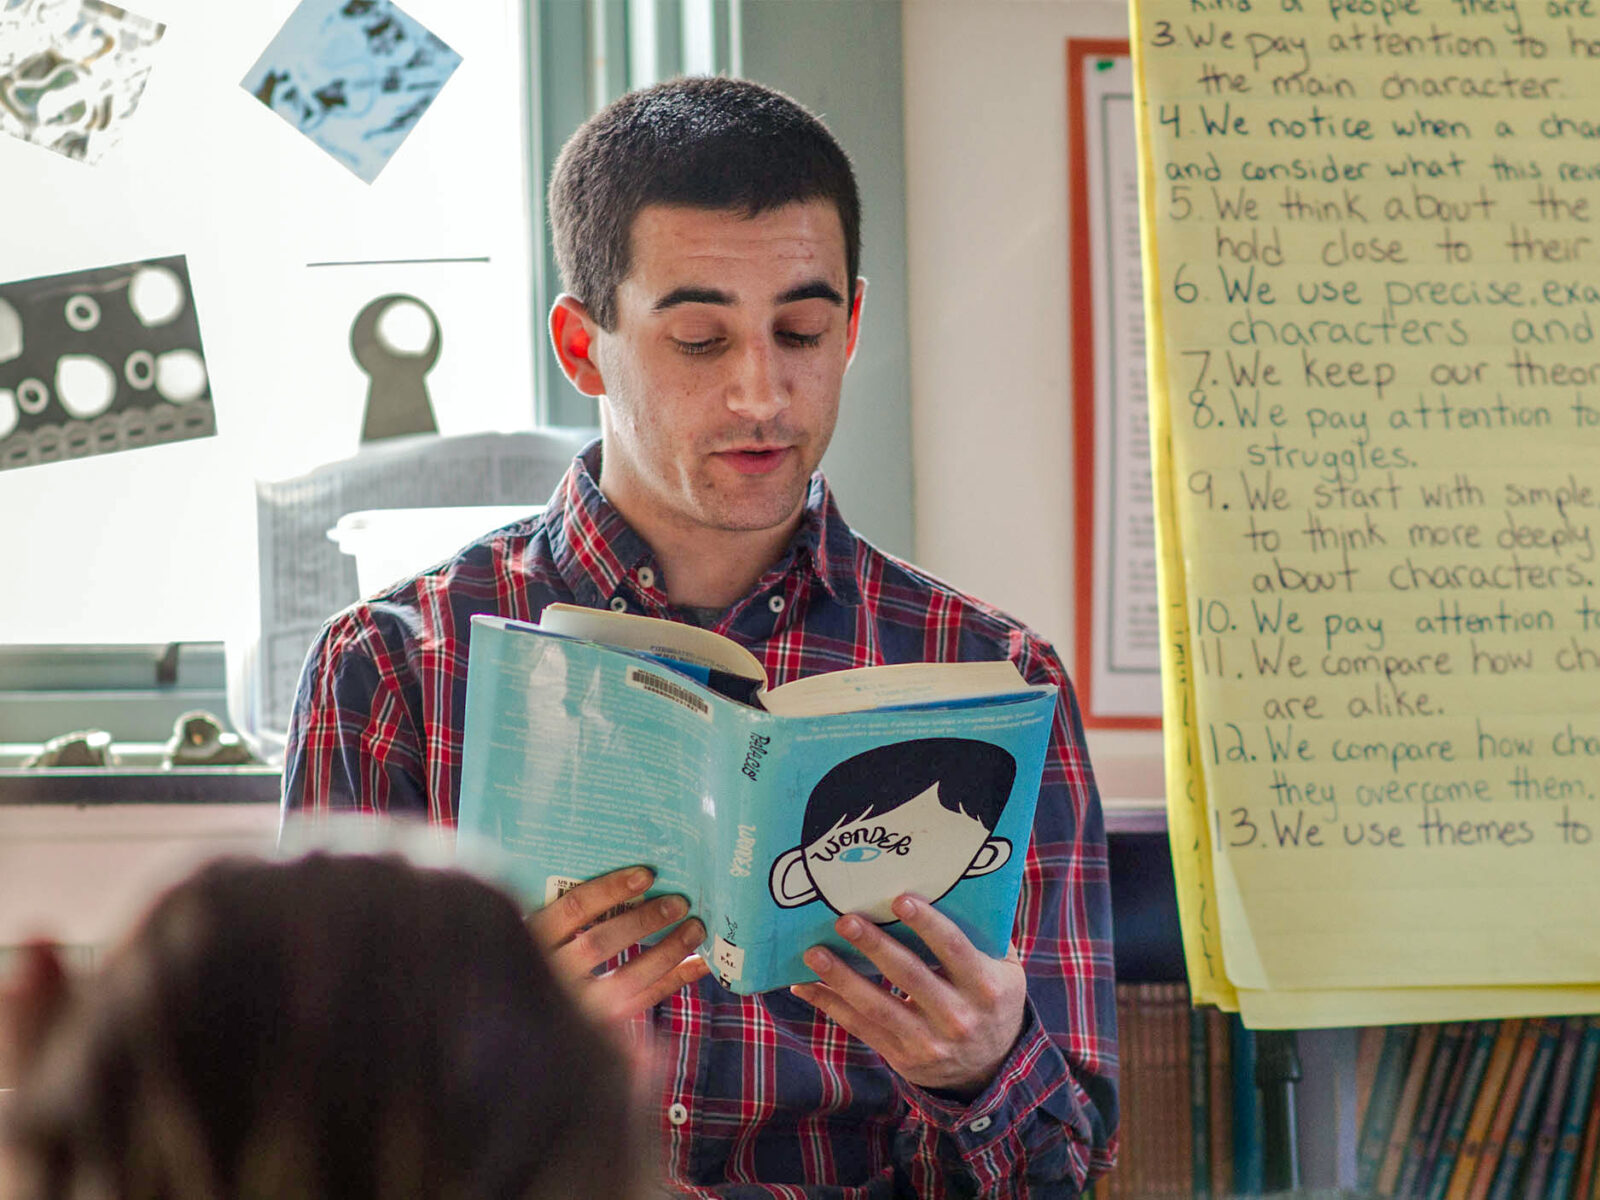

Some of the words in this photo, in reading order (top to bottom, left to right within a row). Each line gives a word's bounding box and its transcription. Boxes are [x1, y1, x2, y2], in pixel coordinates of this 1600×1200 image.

[1185, 21, 1235, 49] We
[1245, 33, 1311, 76] pay
[1328, 22, 1496, 56] attention
[1512, 34, 1548, 59] to
[1197, 63, 1252, 95] the
[1272, 73, 1356, 97] main
[1199, 102, 1249, 136] We
[1268, 105, 1375, 139] notice
[1392, 109, 1471, 139] when
[1495, 120, 1515, 138] a
[1540, 112, 1600, 139] cha
[1165, 151, 1222, 182] and
[1241, 153, 1371, 183] consider
[1386, 151, 1467, 179] what
[1488, 153, 1543, 182] this
[1211, 186, 1259, 220] We
[1279, 186, 1368, 223] think
[1383, 183, 1497, 222] about
[1529, 183, 1590, 222] the
[1216, 226, 1285, 267] hold
[1321, 227, 1409, 267] close
[1435, 226, 1473, 264] to
[1505, 222, 1592, 264] their
[1217, 265, 1276, 305] We
[1297, 281, 1362, 305] use
[1228, 308, 1469, 346] characters
[1511, 309, 1595, 345] and
[1181, 350, 1218, 391] 7.
[1225, 348, 1282, 387] We
[1301, 348, 1396, 399] keep
[1430, 361, 1489, 386] our
[1188, 388, 1225, 429] 8.
[1229, 388, 1288, 428] We
[1306, 407, 1370, 445] pay
[1388, 392, 1551, 430] attention
[1570, 391, 1600, 428] to
[1247, 431, 1418, 483] struggles.
[1188, 469, 1229, 511] 9.
[1240, 469, 1290, 511] We
[1314, 470, 1402, 510] start
[1420, 472, 1484, 509] with
[1243, 514, 1280, 552] to
[1302, 508, 1387, 553] think
[1408, 524, 1482, 548] more
[1496, 509, 1595, 562] deeply
[1252, 556, 1360, 593] about
[1389, 552, 1594, 591] characters.
[1197, 597, 1237, 636] 10.
[1251, 597, 1304, 634] We
[1324, 614, 1385, 651] pay
[1415, 598, 1555, 635] attention
[1201, 637, 1243, 679] 11.
[1251, 636, 1308, 678] We
[1322, 653, 1452, 692] compare
[1470, 637, 1533, 675] how
[1263, 695, 1324, 720] are
[1348, 681, 1444, 718] alike.
[1209, 722, 1257, 765] 12.
[1265, 723, 1316, 763] We
[1332, 739, 1454, 773] compare
[1476, 717, 1535, 761] how
[1268, 769, 1338, 823] they
[1356, 780, 1494, 806] overcome
[1508, 765, 1595, 801] them.
[1215, 807, 1267, 852] 13.
[1270, 809, 1324, 848] We
[1343, 823, 1405, 847] use
[1418, 803, 1535, 847] themes
[1555, 805, 1593, 845] to
